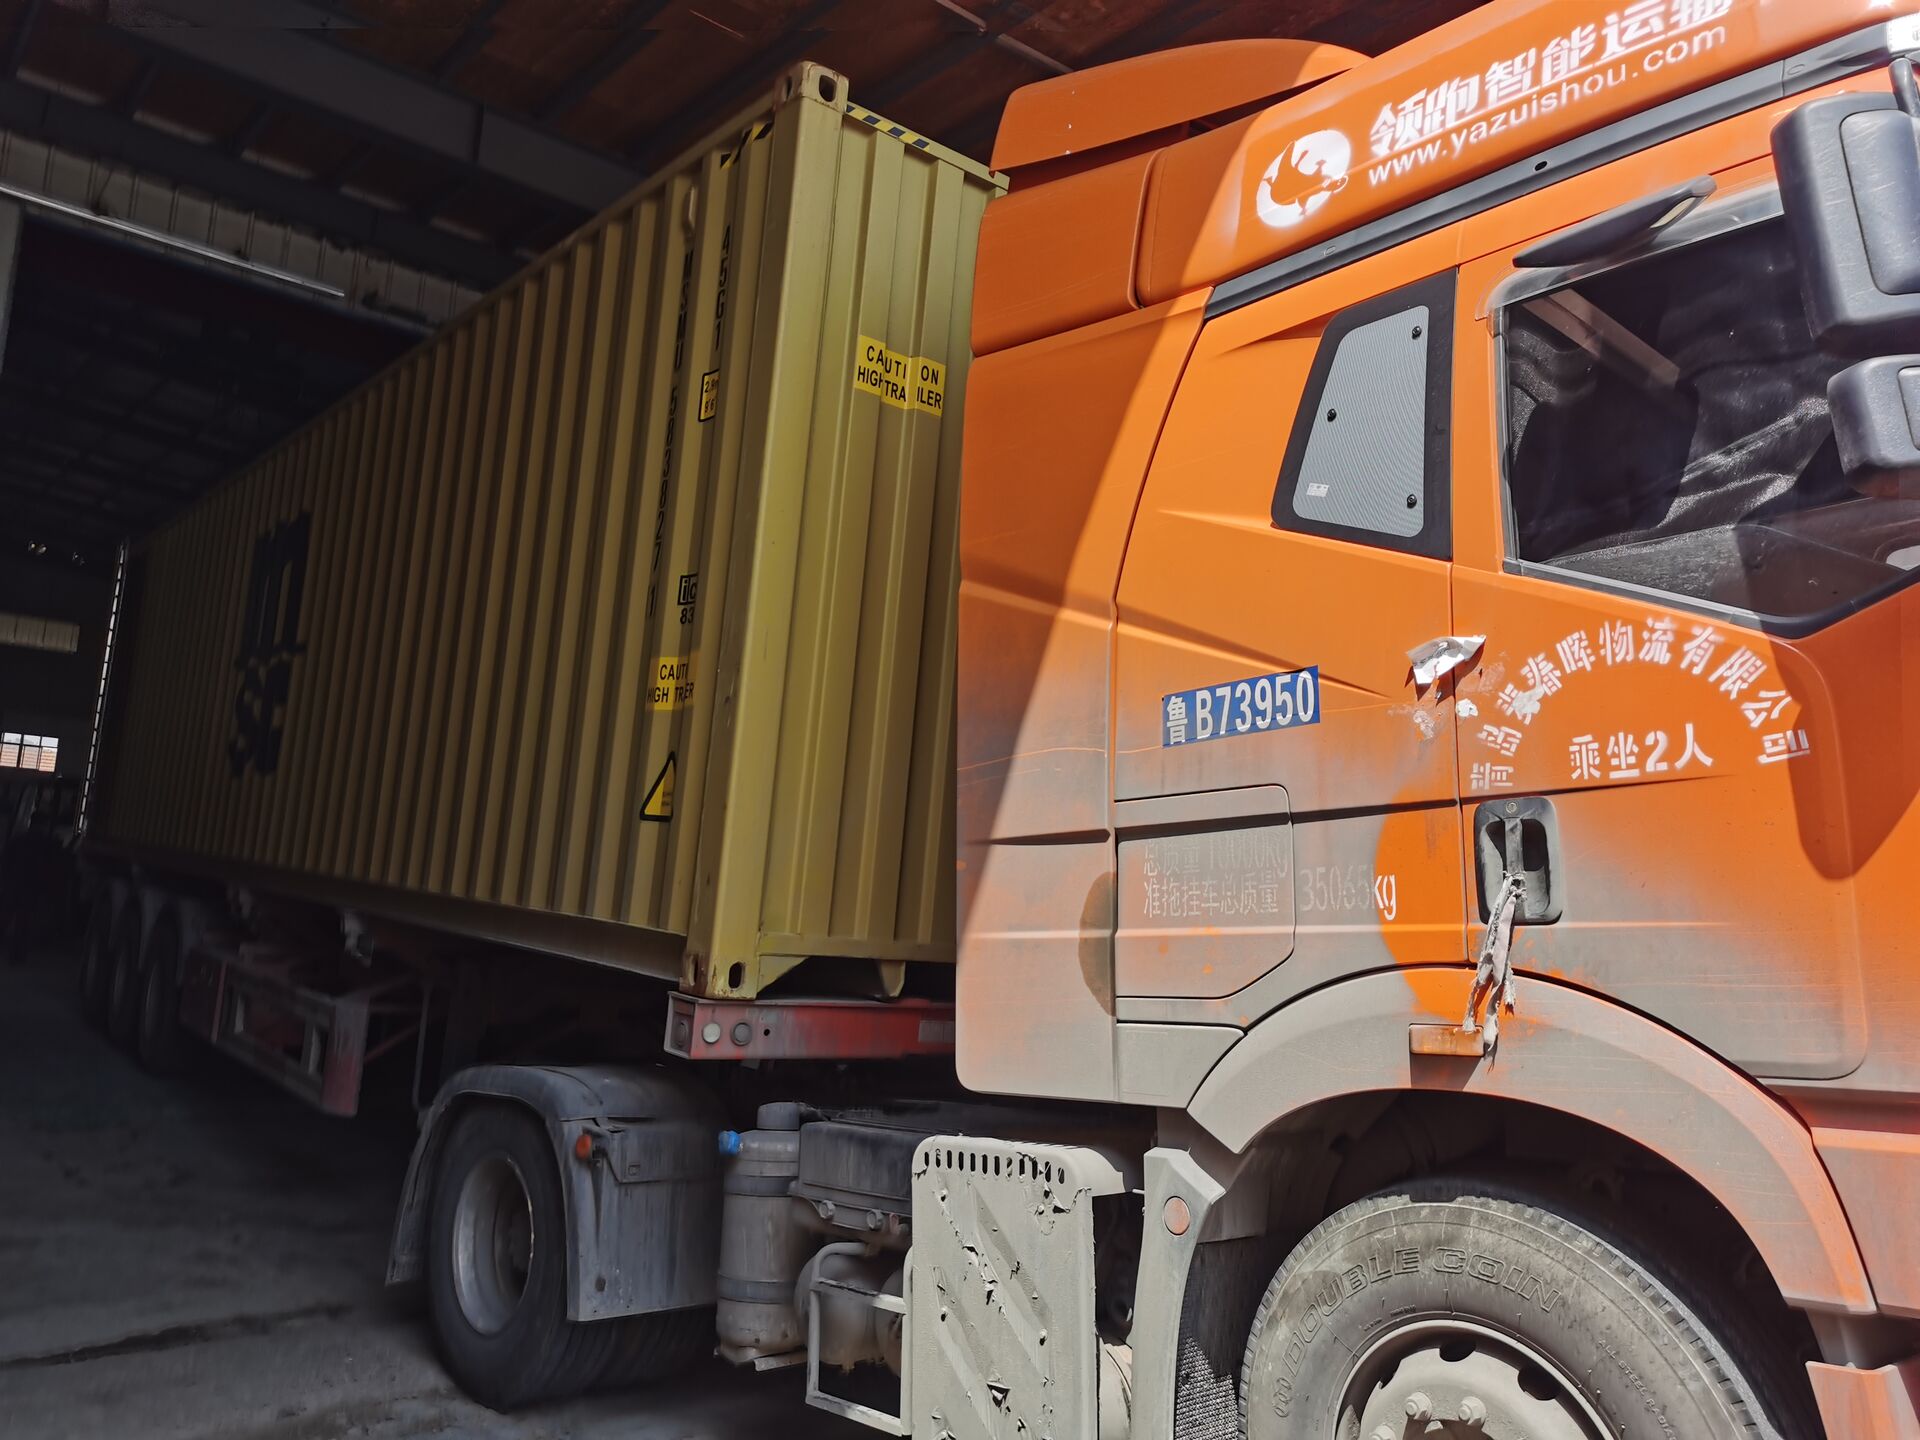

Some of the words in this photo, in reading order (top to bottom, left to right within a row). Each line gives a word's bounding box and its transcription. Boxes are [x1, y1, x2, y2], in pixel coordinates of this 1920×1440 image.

[1367, 25, 1725, 187] www.yazuishou.com
[866, 345, 939, 385] CAUTION
[884, 380, 942, 409] TRAILER
[679, 607, 694, 624] 83
[647, 686, 669, 703] HIGH
[1167, 671, 1315, 745] 鲁B73950
[1569, 722, 1714, 781] 乘坐2人
[1144, 869, 1279, 919] 准拖挂车总质量
[1298, 865, 1396, 921] 35065kg
[1282, 1247, 1420, 1377] DOUBLE
[1431, 1246, 1562, 1313] COIN
[1618, 1360, 1650, 1396] STEEL
